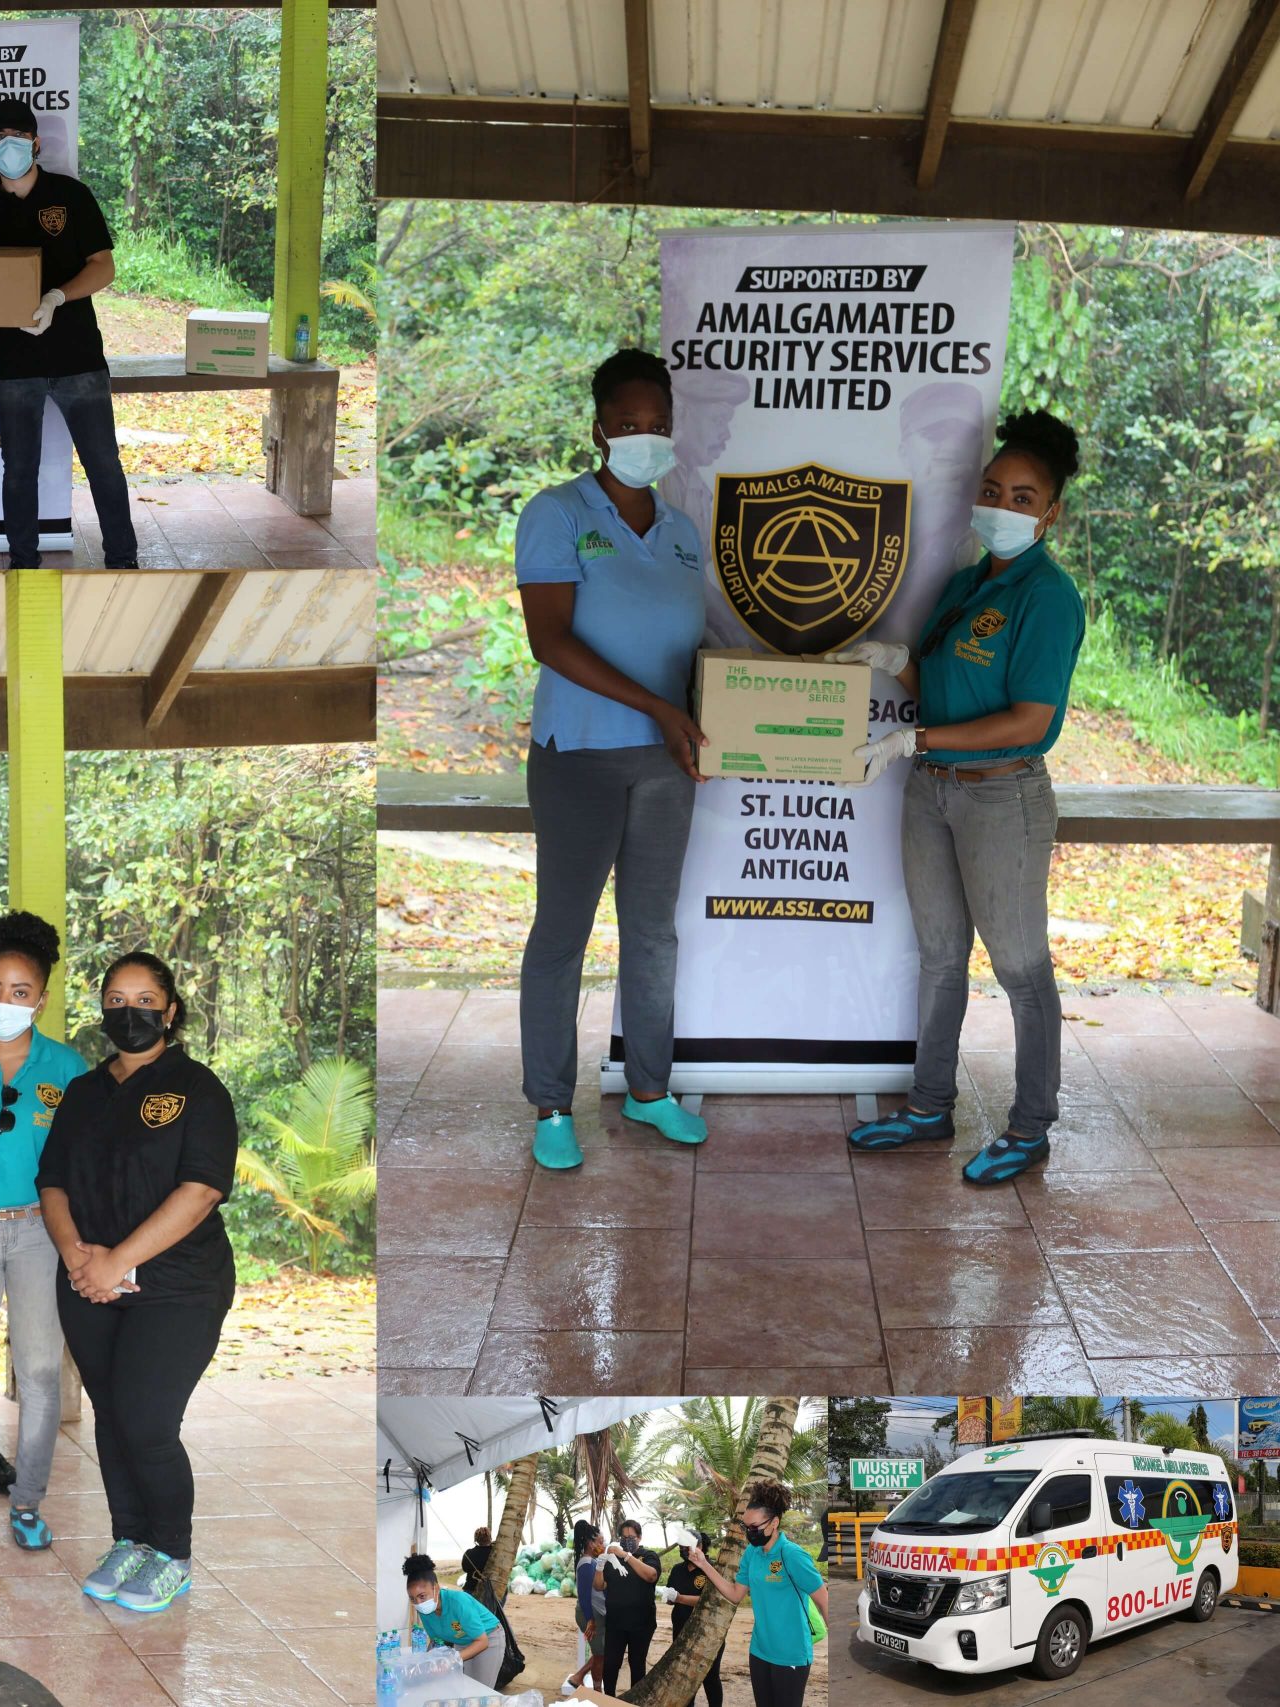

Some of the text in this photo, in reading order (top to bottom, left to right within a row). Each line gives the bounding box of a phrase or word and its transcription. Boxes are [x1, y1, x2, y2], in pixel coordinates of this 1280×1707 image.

[0, 47, 19, 62] BY
[749, 268, 913, 290] SUPPORTED BY
[696, 302, 955, 335] AMALGAMATED
[197, 327, 256, 337] BODYGUARD
[670, 339, 992, 375] SECURITY SERVICES
[753, 377, 892, 411] LIMITED
[736, 471, 883, 500] AMALGAMATED
[585, 540, 614, 549] GREEN
[720, 524, 760, 617] SECURITY
[847, 534, 901, 622] SERVICES
[727, 665, 747, 675] THE
[725, 675, 847, 694] BODYGUARD
[808, 693, 846, 703] SERIES
[740, 794, 855, 820] ST. LUCIA
[744, 827, 849, 853] GUYANA
[740, 858, 849, 882] ANTIGUA
[712, 899, 868, 920] WWW.ASSL.COM
[857, 1461, 918, 1475] MUSTER
[1132, 1455, 1210, 1476] ARCHANGEL AMBULANCE SERVICES
[865, 1475, 910, 1488] POINT
[1107, 1577, 1193, 1622] 800-LIVE
[890, 1636, 906, 1651] 9217
